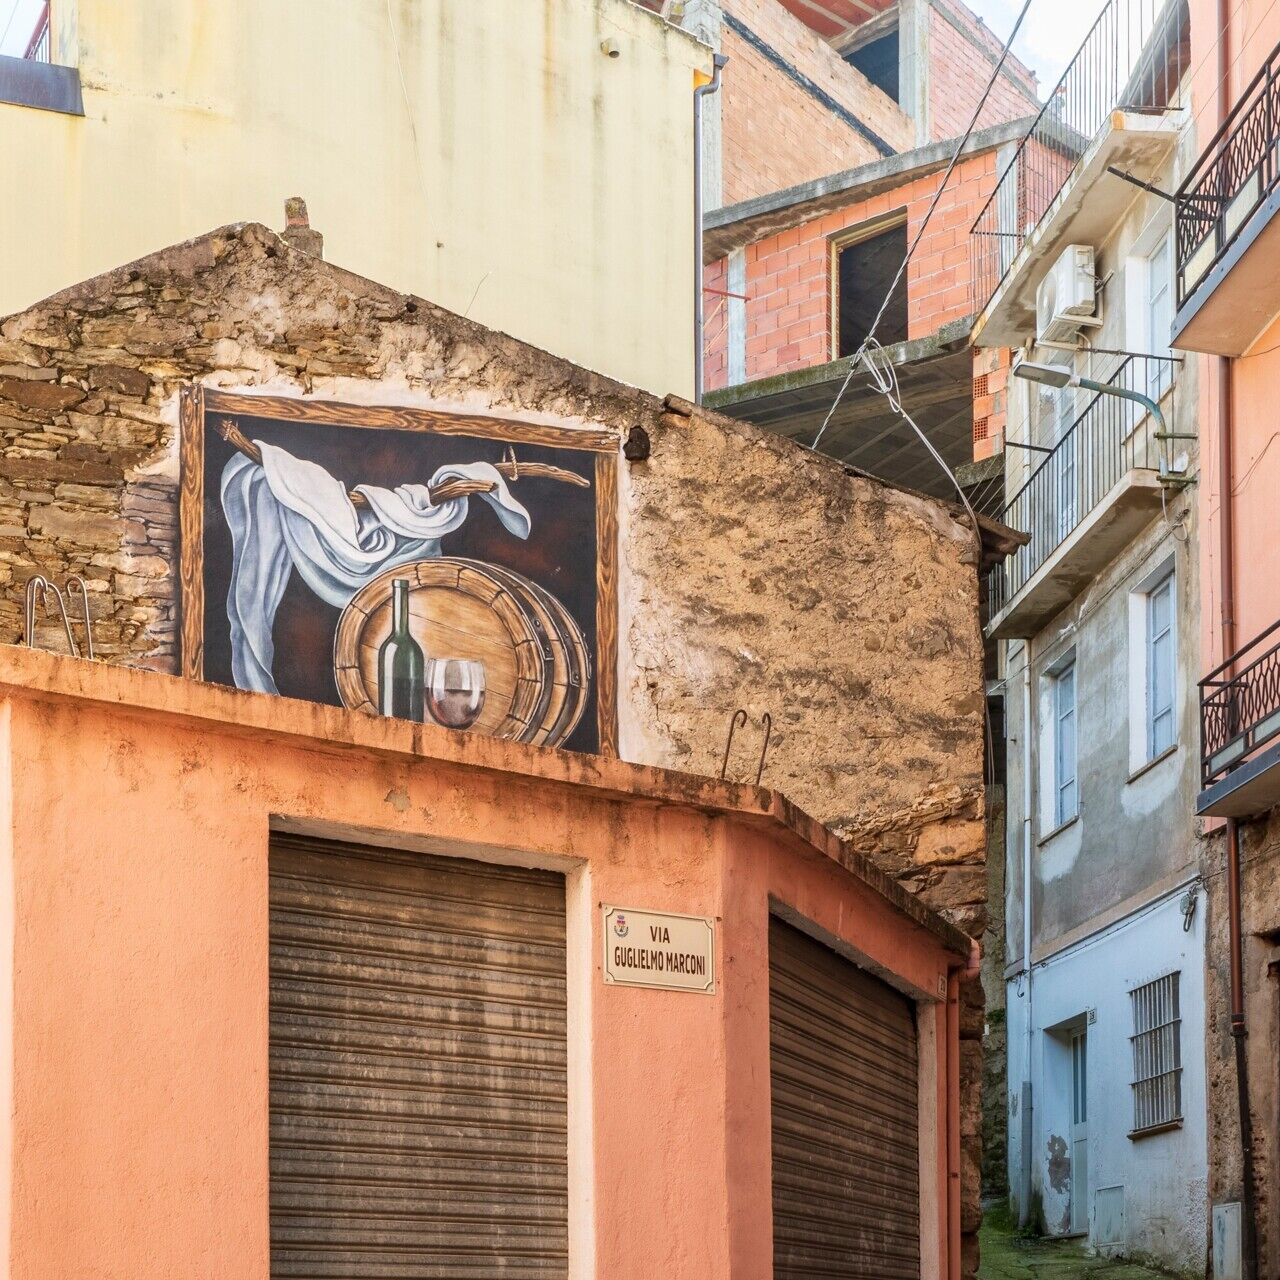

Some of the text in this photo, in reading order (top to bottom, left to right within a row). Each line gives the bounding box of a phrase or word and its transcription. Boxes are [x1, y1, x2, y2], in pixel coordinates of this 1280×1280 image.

[650, 925, 670, 944] VIA
[614, 946, 705, 975] GUGLIELMO MARCONI
